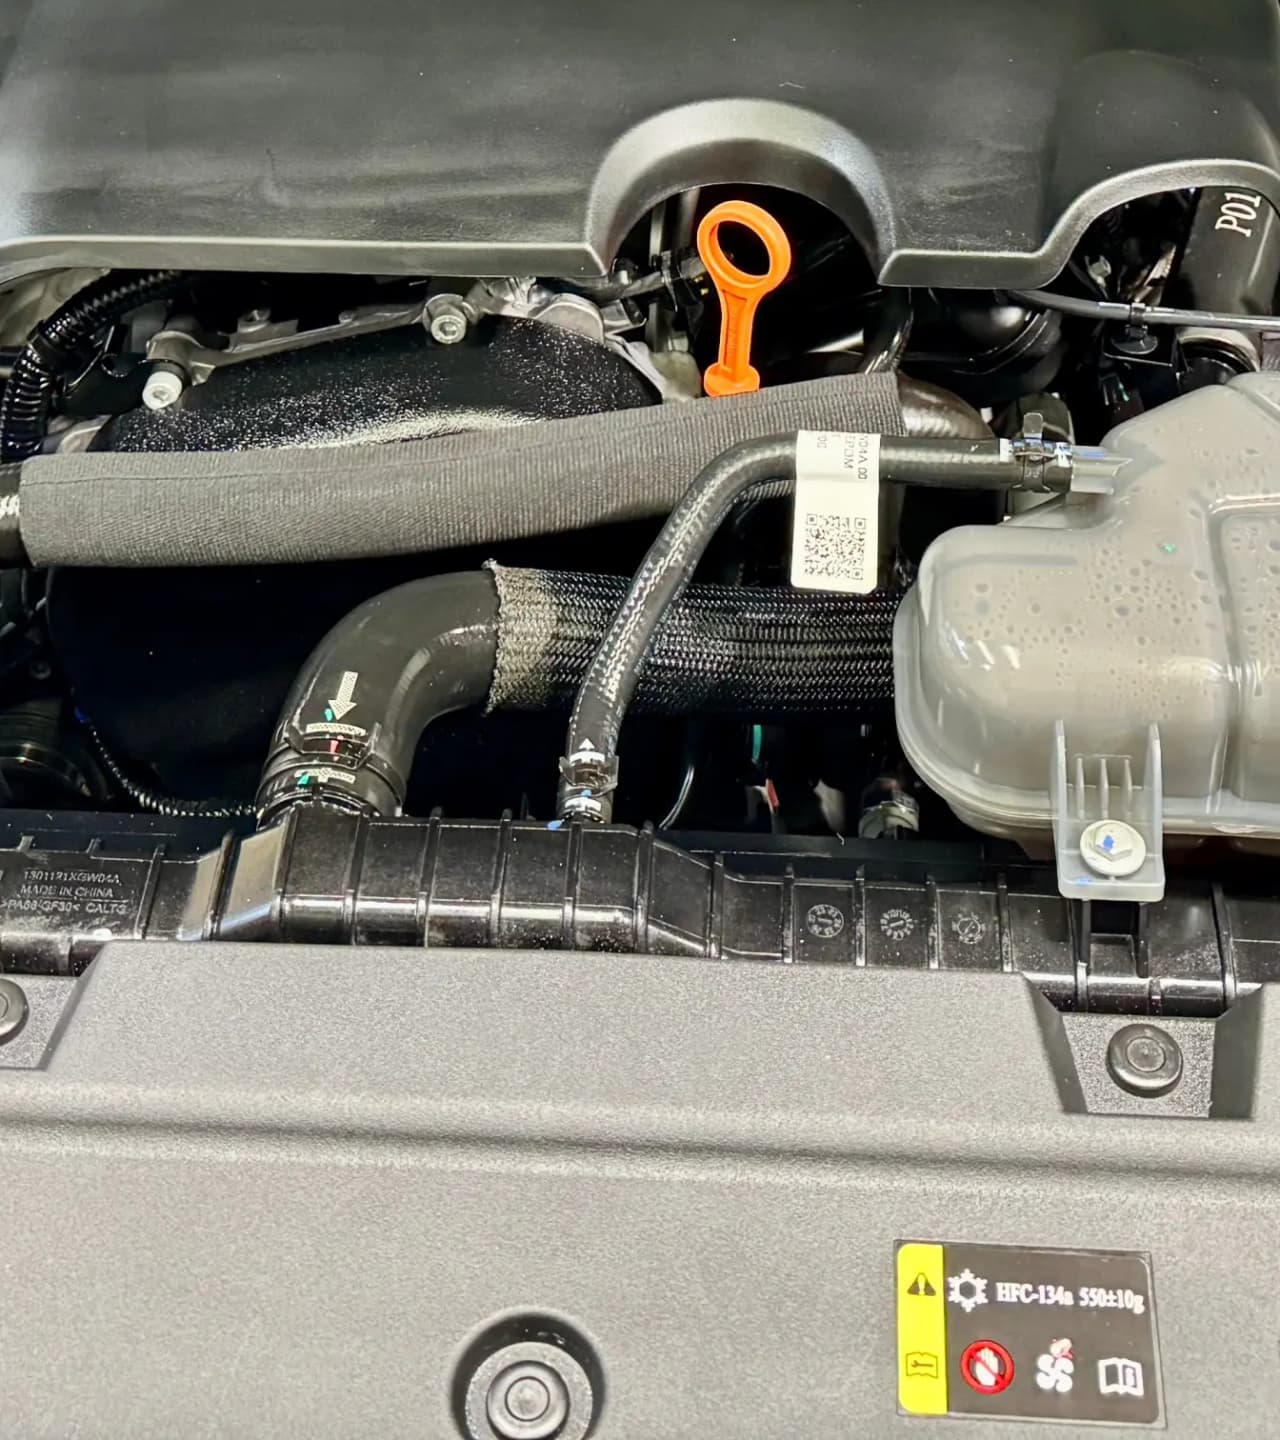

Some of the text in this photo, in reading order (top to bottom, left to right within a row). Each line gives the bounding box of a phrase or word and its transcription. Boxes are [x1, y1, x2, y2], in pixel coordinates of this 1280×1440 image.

[20, 883, 114, 898] MADE IN CHINA
[995, 1281, 1146, 1314] HFC-134a 550±10g
